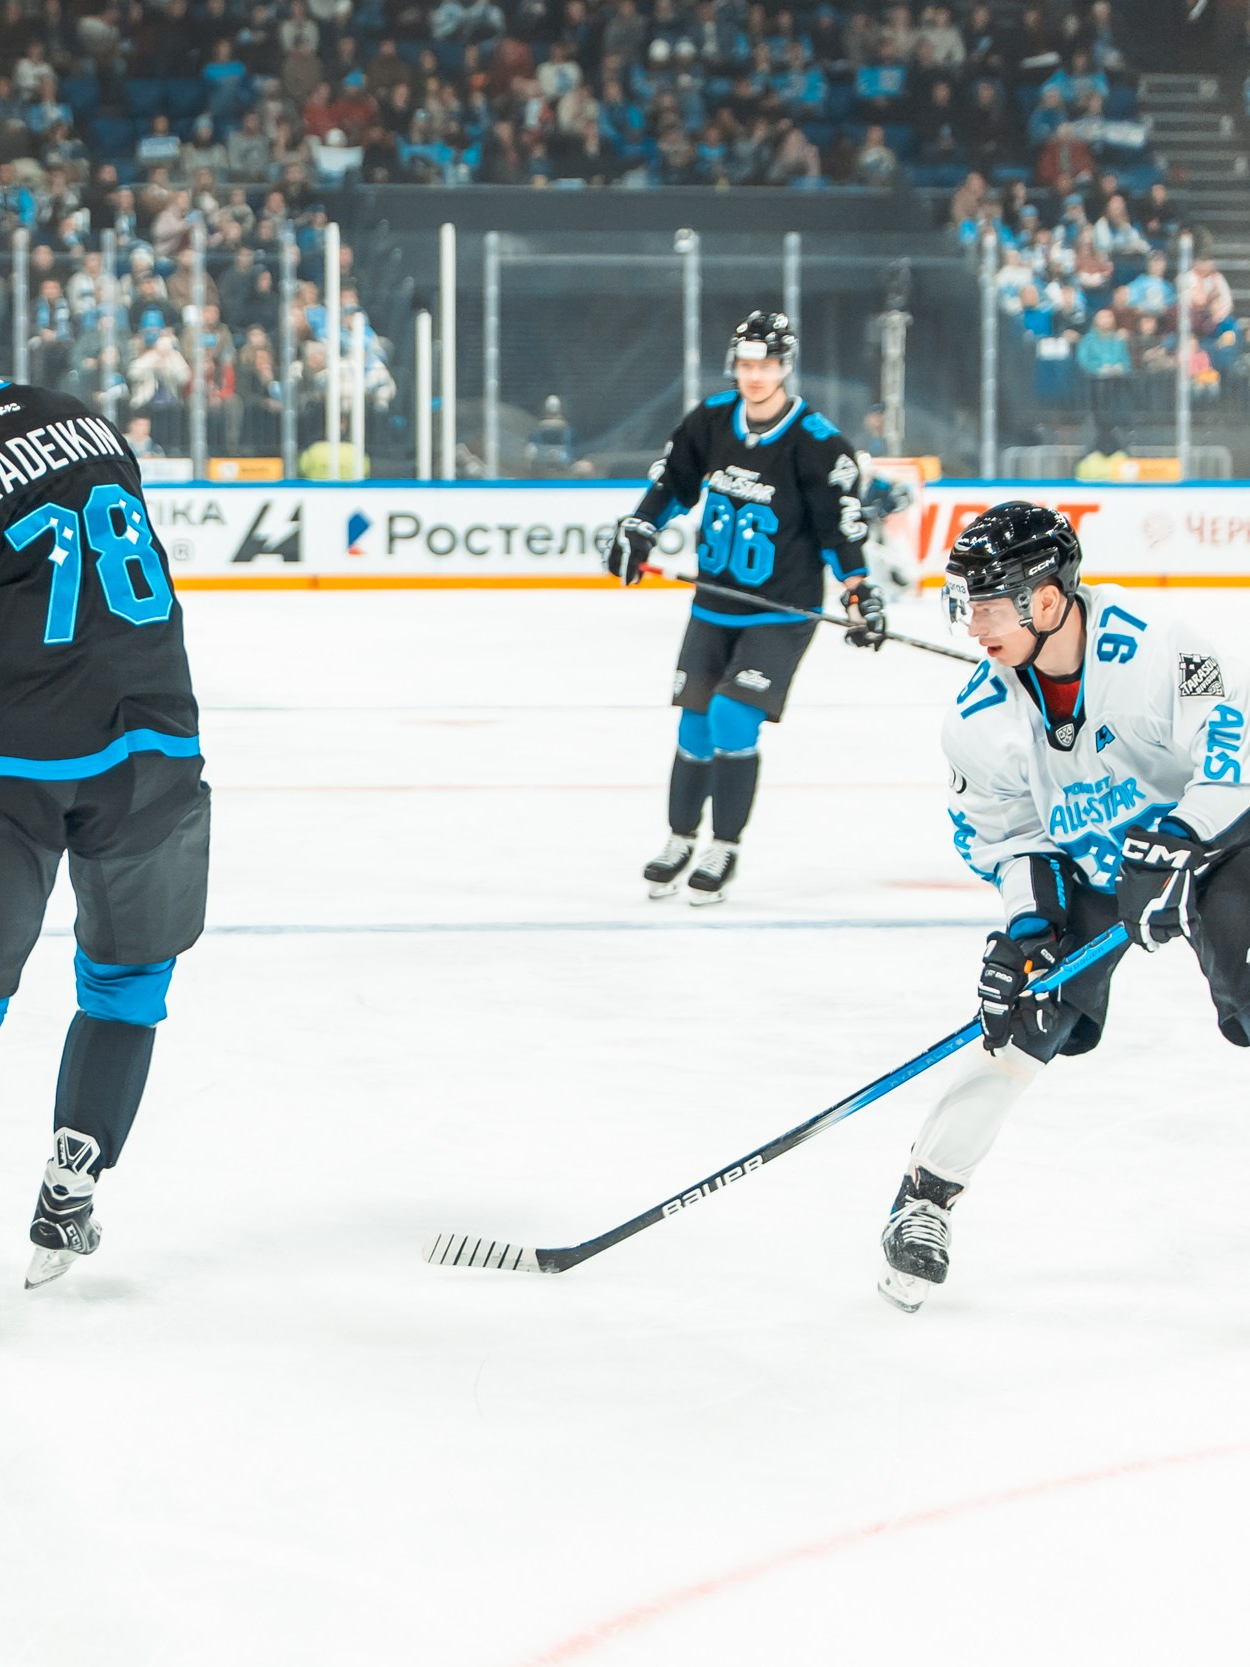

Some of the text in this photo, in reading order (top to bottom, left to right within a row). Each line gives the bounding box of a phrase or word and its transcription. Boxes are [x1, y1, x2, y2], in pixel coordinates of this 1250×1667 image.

[3, 483, 173, 645] 78
[386, 511, 699, 557] Ростелео
[697, 491, 780, 588] 96
[1028, 557, 1056, 576] CCM
[1096, 604, 1148, 665] 97
[955, 659, 1009, 720] 97
[661, 1154, 764, 1218] BAUER
